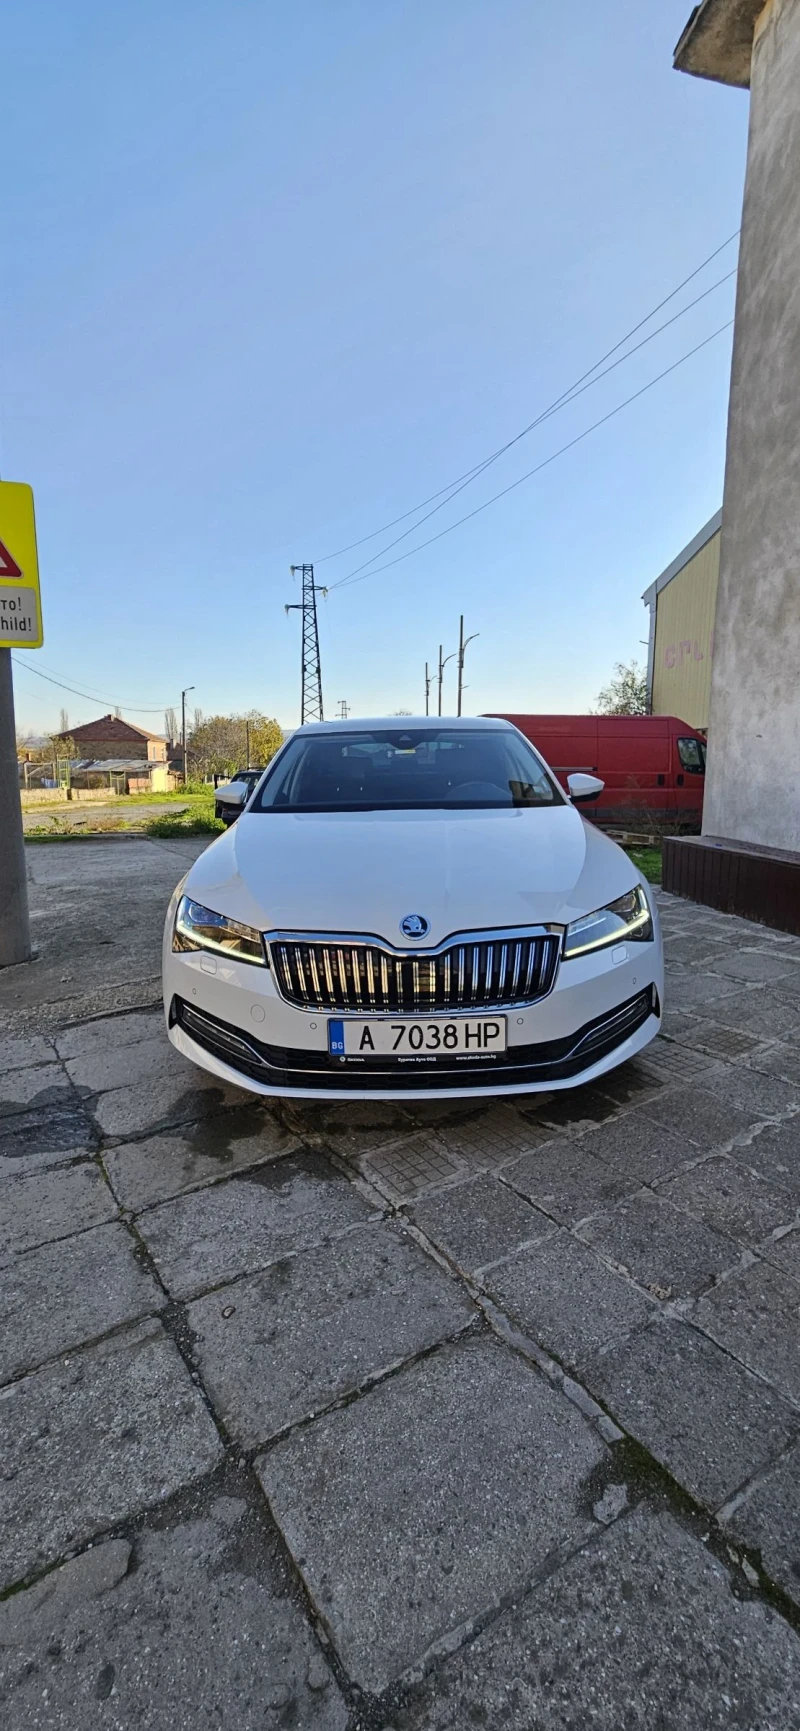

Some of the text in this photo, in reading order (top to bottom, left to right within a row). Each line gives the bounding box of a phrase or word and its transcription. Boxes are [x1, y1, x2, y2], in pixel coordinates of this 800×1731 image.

[359, 1022, 500, 1051] A 7038 HP
[331, 1042, 343, 1050] BG
